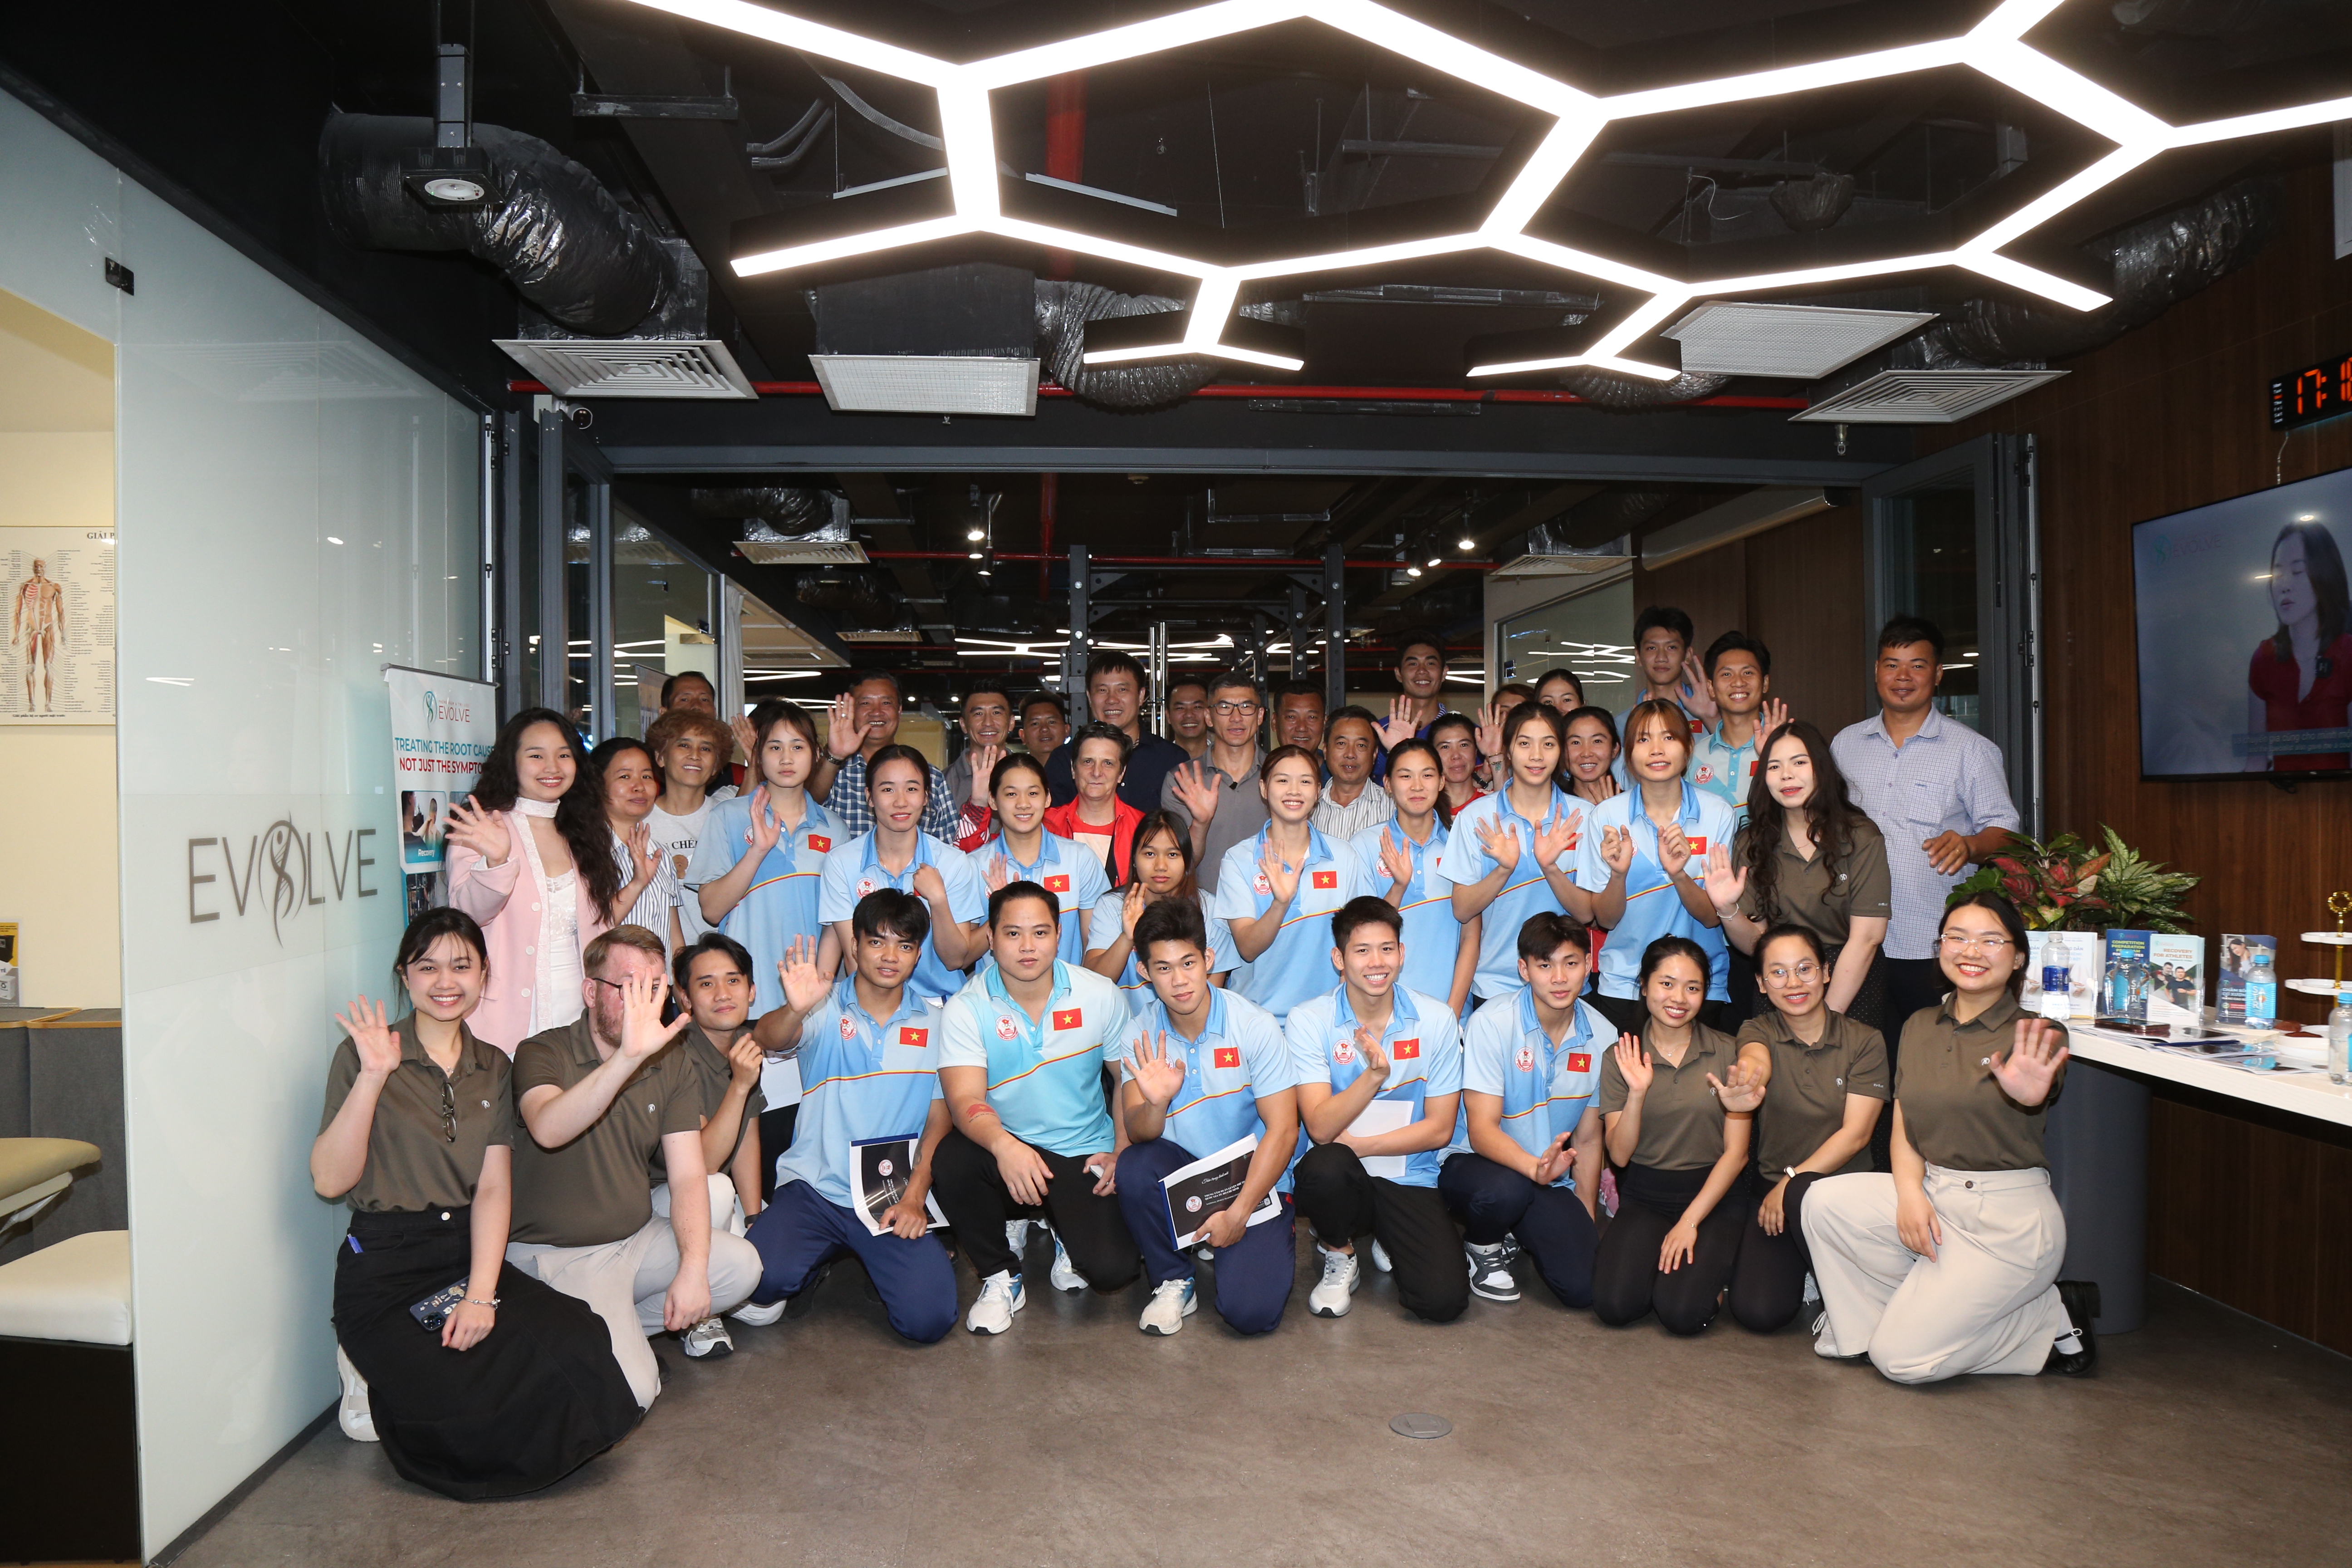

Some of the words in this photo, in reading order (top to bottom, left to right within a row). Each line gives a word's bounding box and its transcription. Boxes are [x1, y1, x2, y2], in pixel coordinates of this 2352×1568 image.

[2173, 534, 2221, 557] EVOLVE
[439, 705, 470, 722] EVOLVE
[395, 737, 432, 753] TREATING
[434, 741, 449, 754] THE
[451, 743, 472, 756] ROOT
[399, 757, 416, 771] NOT
[418, 758, 435, 772] JUST
[436, 760, 451, 773] THE
[452, 761, 482, 774] SYMPTO
[418, 848, 435, 857] Recovery
[189, 818, 377, 932] EVOLVE
